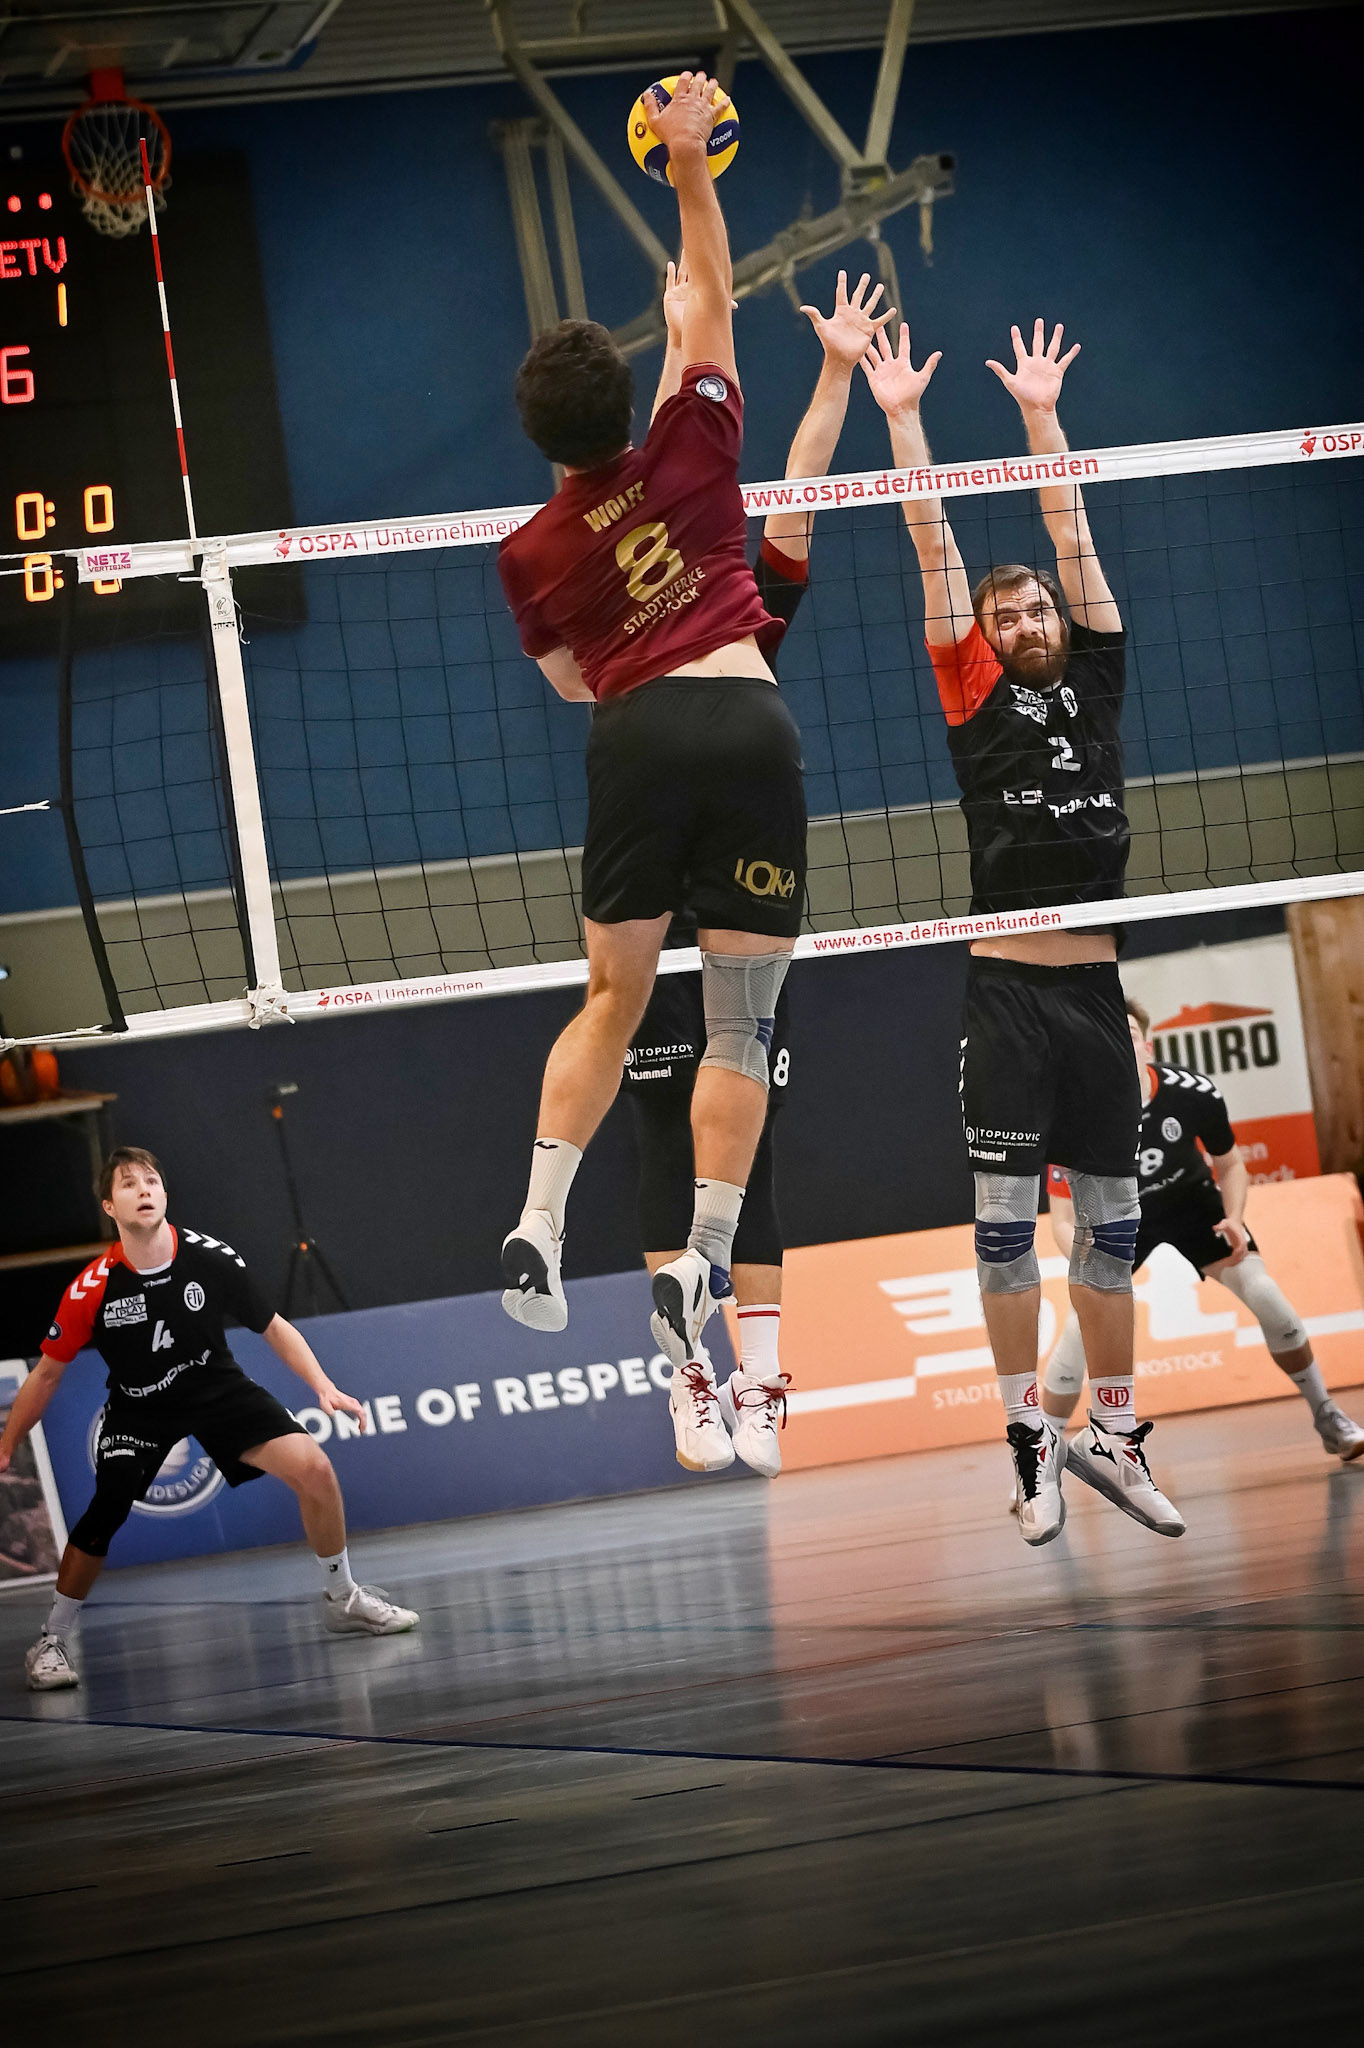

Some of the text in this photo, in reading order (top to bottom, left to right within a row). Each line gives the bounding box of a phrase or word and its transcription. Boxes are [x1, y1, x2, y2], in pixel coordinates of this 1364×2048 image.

[709, 129, 733, 147] V200W
[0, 236, 67, 279] ETV
[1322, 433, 1364, 452] OSP
[299, 519, 520, 554] OSPA Unternehmen
[86, 552, 131, 567] NETZ
[615, 522, 684, 603] 8
[623, 566, 706, 635] STADTWERKE
[1047, 736, 1082, 772] 2
[734, 857, 796, 899] LOKA
[813, 911, 1062, 951] www.ospa.de/firmenkunden
[334, 981, 483, 1006] OSPA Unternehmen
[628, 1065, 672, 1081] hummel
[773, 1047, 790, 1087] 8
[979, 1128, 1041, 1142] TOPUZOVIC
[968, 1146, 1006, 1162] hummel
[152, 1319, 175, 1353] 4
[1135, 1350, 1223, 1378] ROSTOCK
[296, 1353, 674, 1445] OME OF RESPEC
